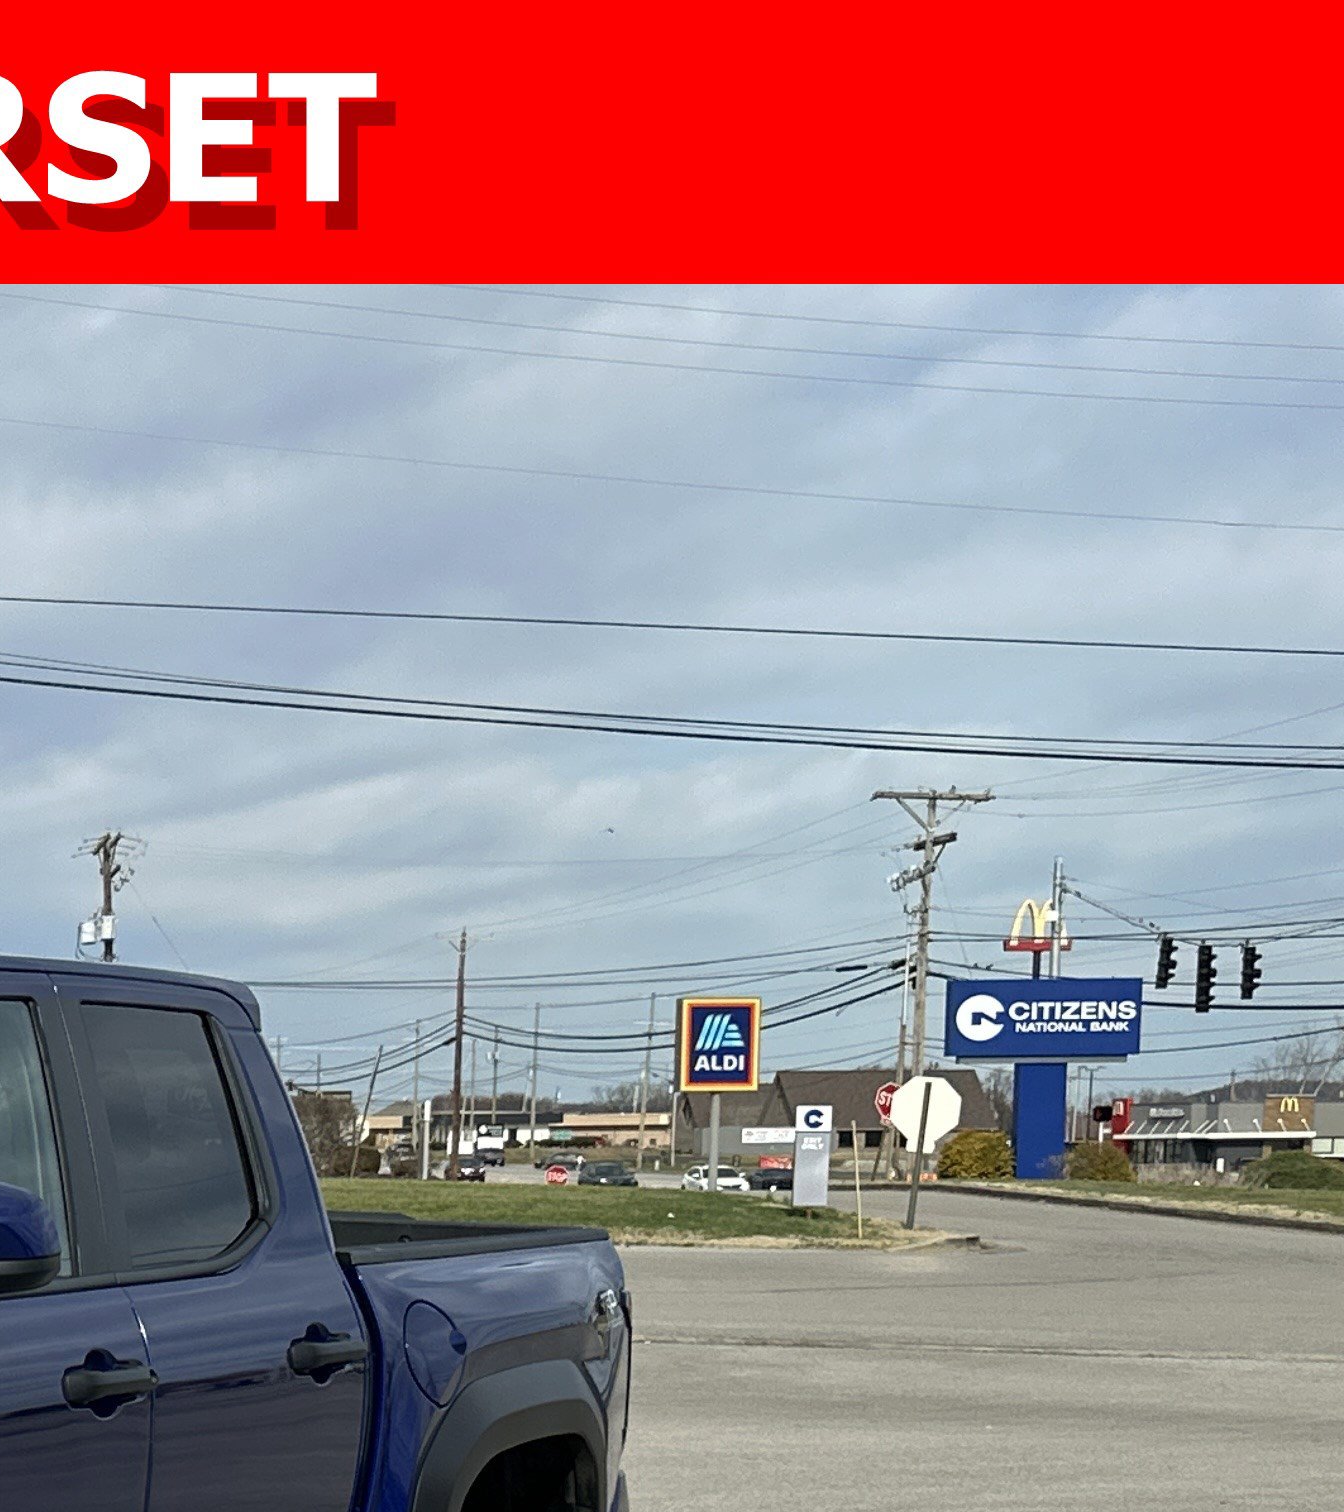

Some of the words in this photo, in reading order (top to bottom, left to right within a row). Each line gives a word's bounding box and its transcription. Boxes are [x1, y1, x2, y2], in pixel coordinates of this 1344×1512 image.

[1008, 1000, 1138, 1021] CITIZENS
[1015, 1021, 1086, 1033] NATIONAL
[1089, 1021, 1130, 1033] BANK
[694, 1054, 745, 1072] ALDI
